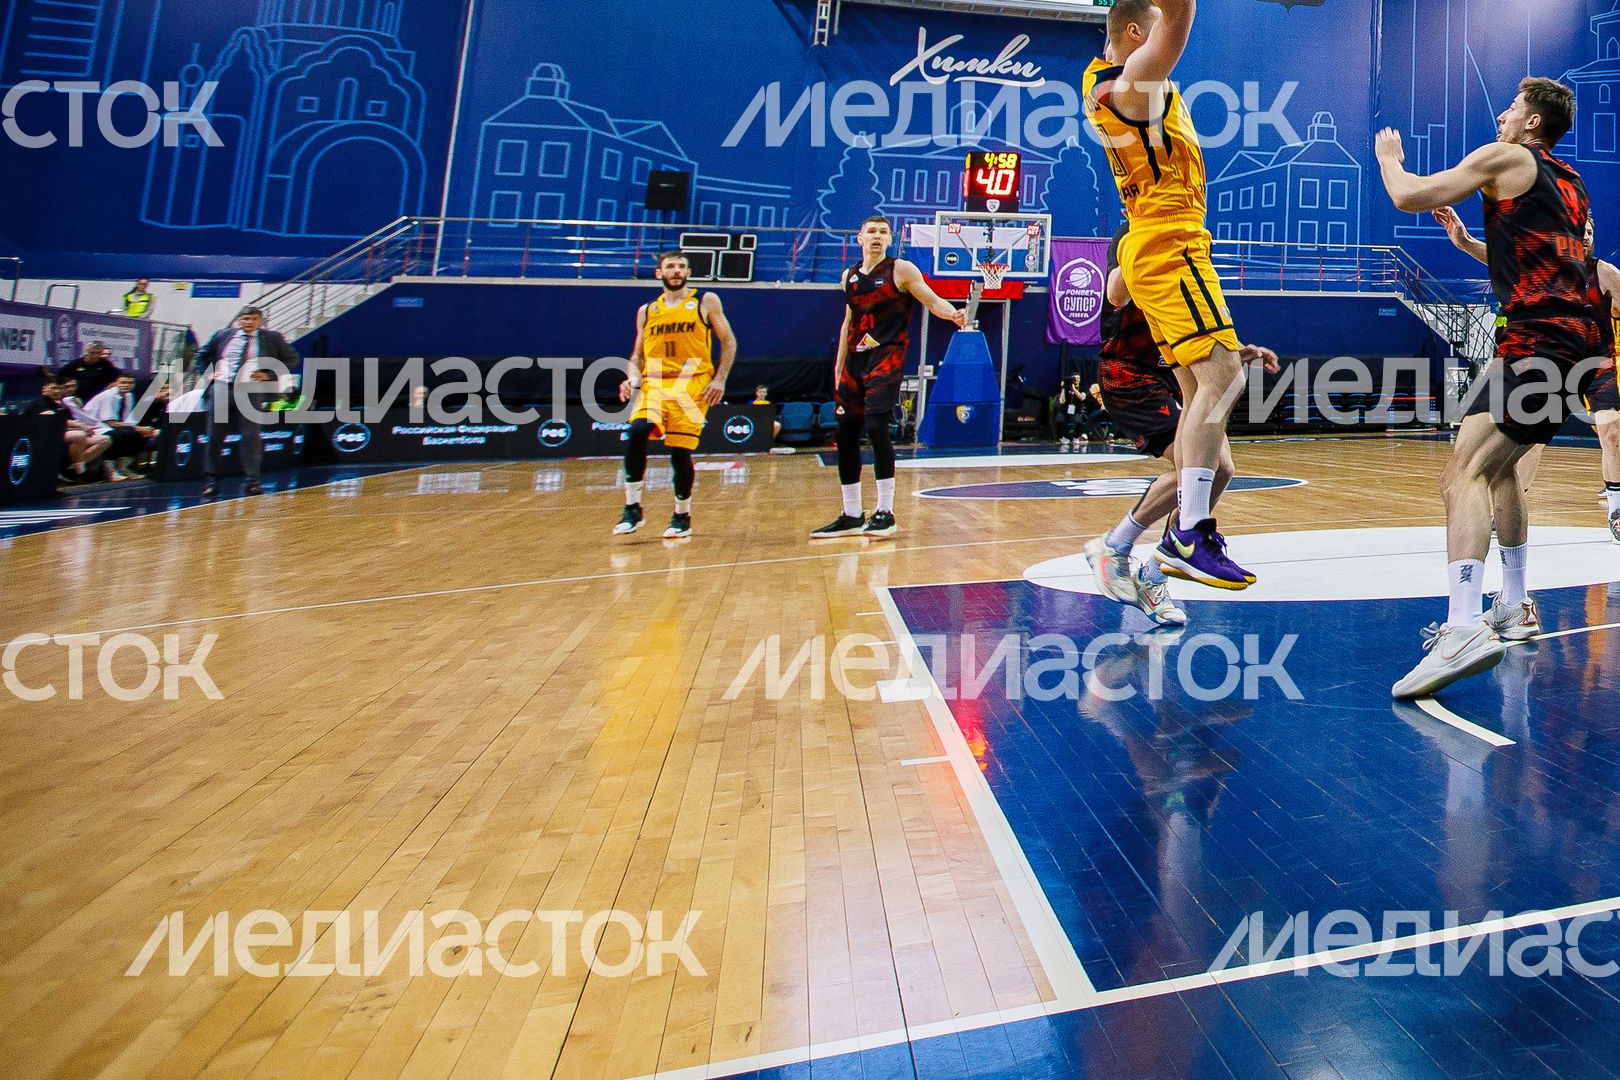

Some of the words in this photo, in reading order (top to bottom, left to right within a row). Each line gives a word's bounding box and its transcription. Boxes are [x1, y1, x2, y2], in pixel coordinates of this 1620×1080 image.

[890, 26, 1045, 87] Химки
[984, 153, 1018, 169] 4:58
[1064, 296, 1096, 312] СУПЕР
[860, 313, 874, 330] 21
